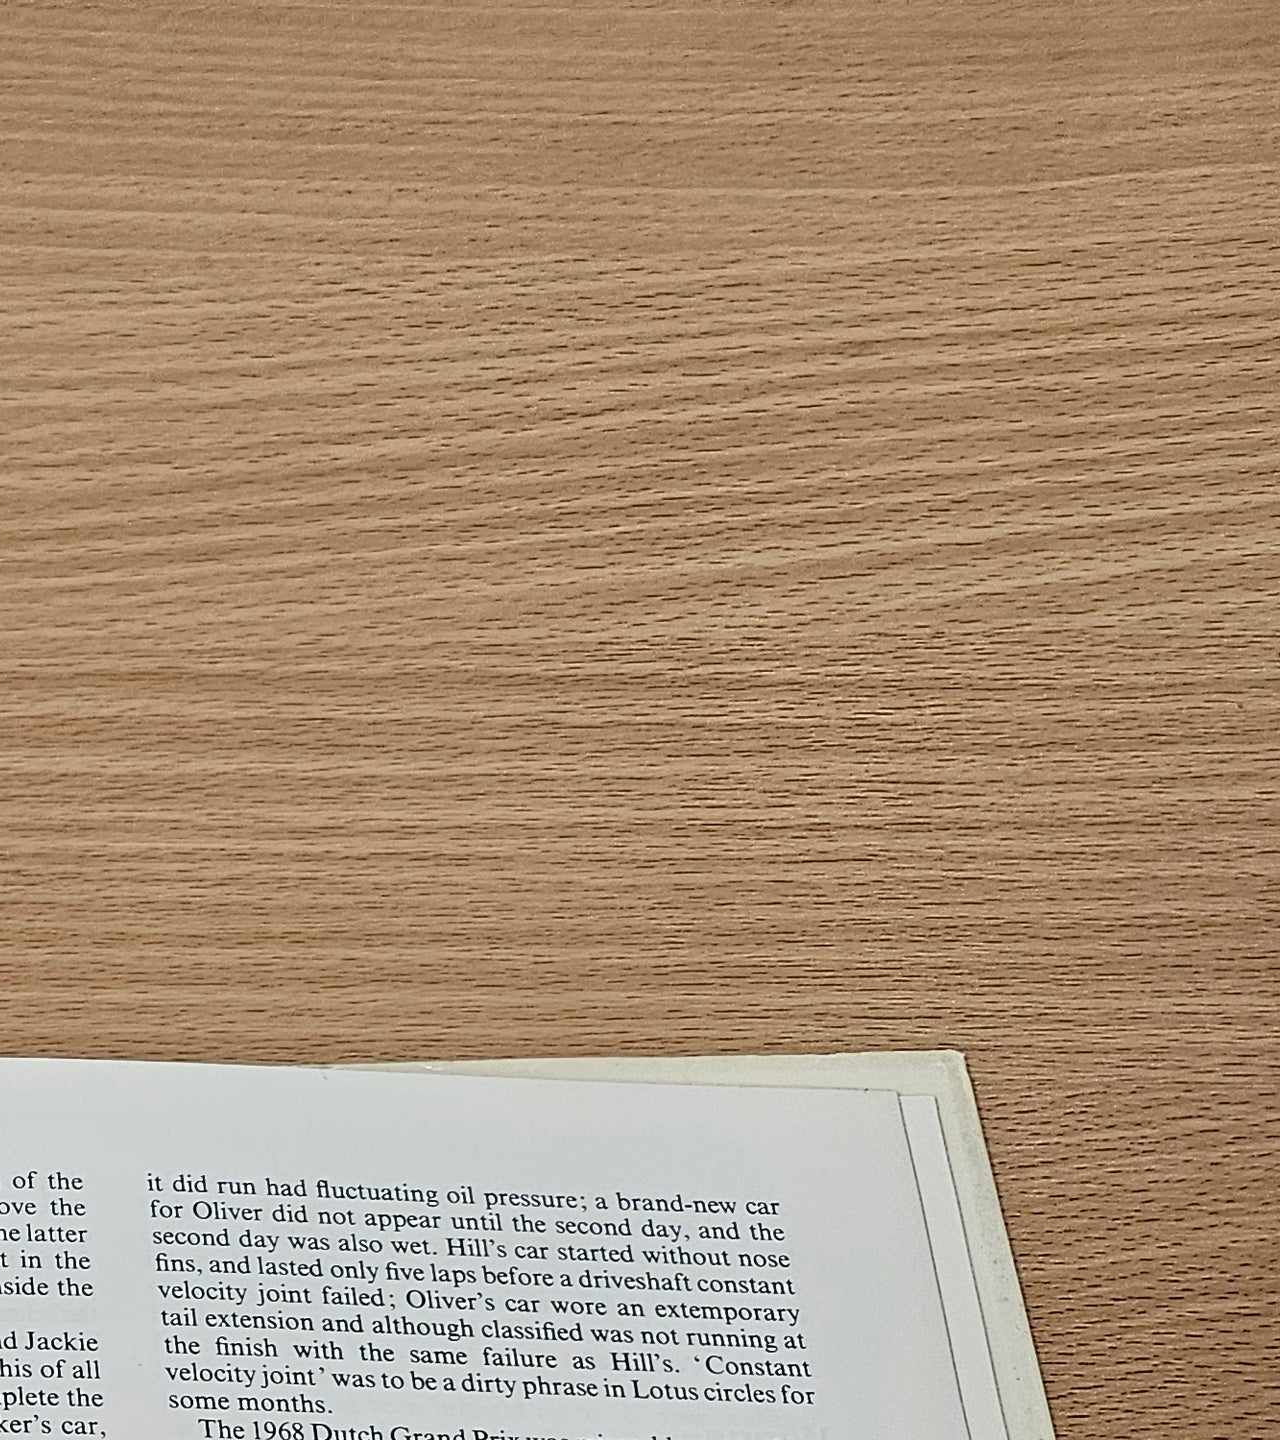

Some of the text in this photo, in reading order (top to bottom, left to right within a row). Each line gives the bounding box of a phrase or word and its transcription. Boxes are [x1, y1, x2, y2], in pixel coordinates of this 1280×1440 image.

[147, 1173, 164, 1192] it
[173, 1174, 208, 1193] did
[217, 1181, 257, 1195] run
[265, 1177, 308, 1197] had
[316, 1180, 439, 1207] fluctuating
[447, 1185, 475, 1204] oil
[595, 1197, 609, 1210] a
[615, 1192, 736, 1214] brand-new
[746, 1202, 780, 1215] car
[50, 1198, 86, 1216] the
[161, 1307, 807, 1353] tail extension and although classified was not running at
[24, 1331, 99, 1351] Jackie
[169, 1393, 333, 1414] some months.
[198, 1419, 245, 1440] The
[253, 1421, 304, 1440] 1968
